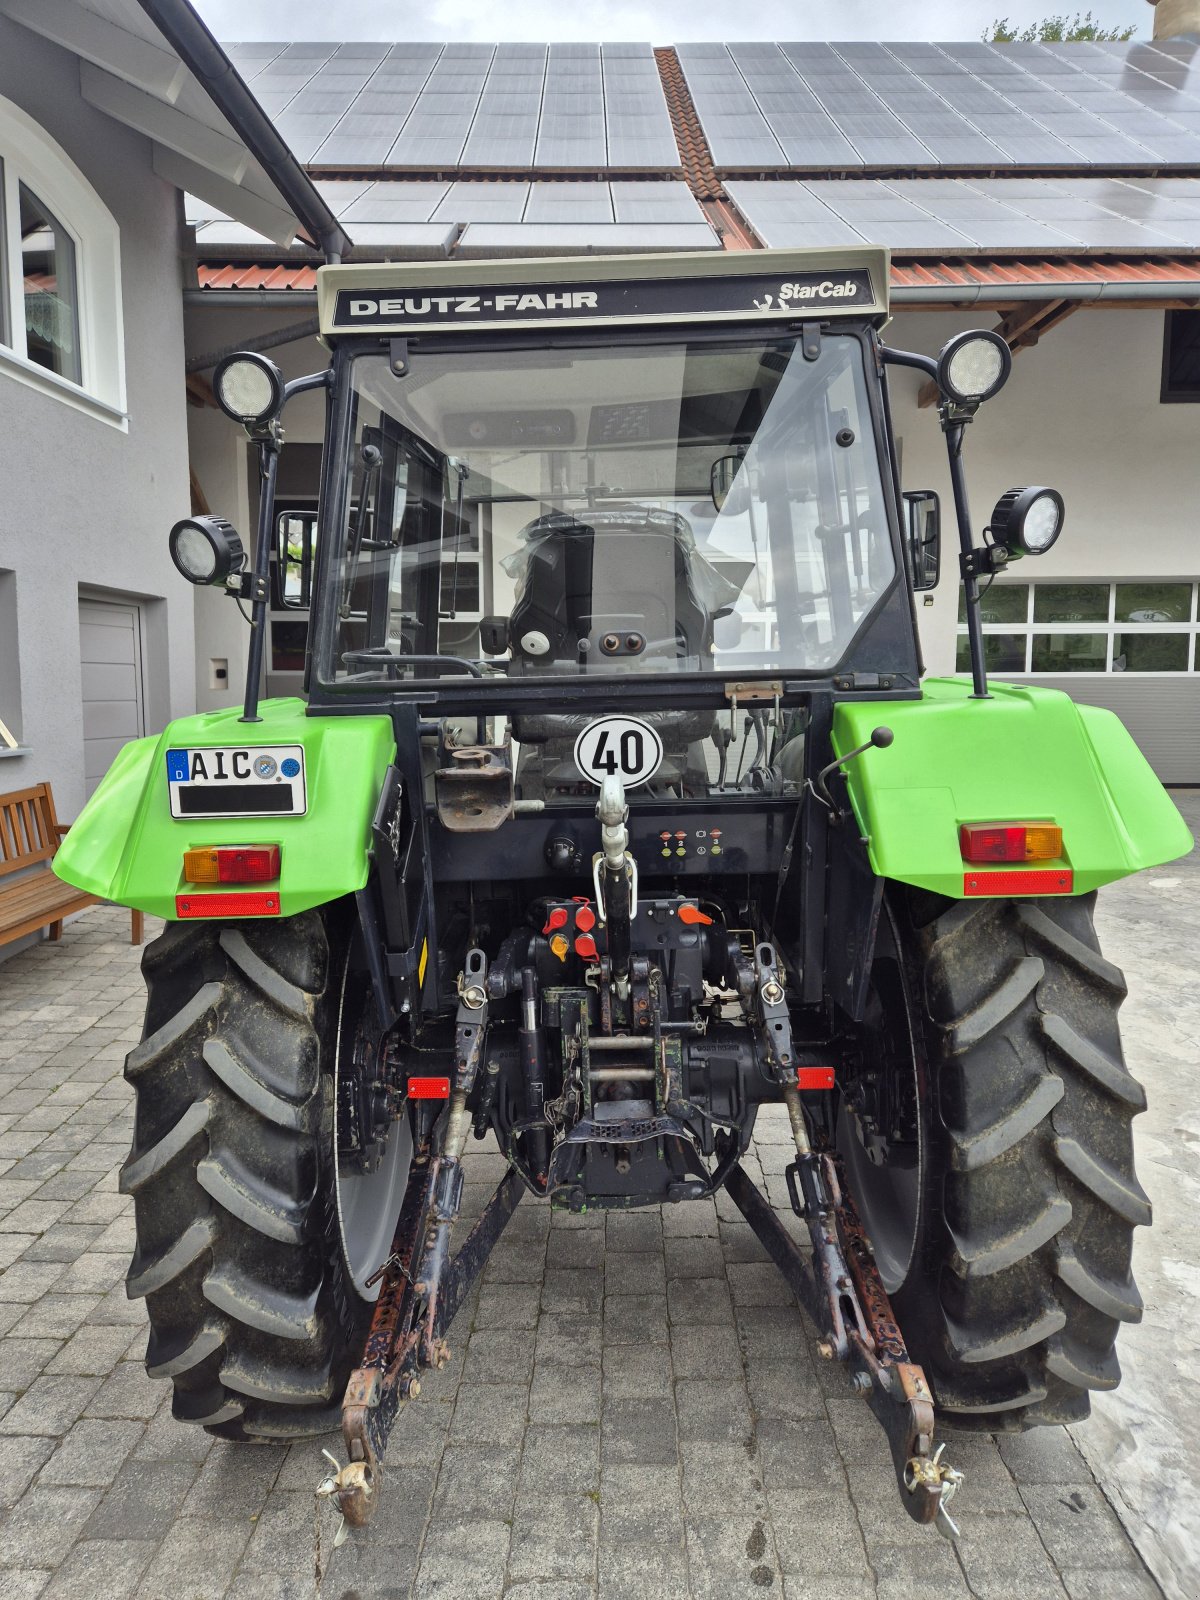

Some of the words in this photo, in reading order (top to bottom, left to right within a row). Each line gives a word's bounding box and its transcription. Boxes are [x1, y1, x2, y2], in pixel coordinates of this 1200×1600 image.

[779, 280, 857, 300] StarCab
[350, 291, 598, 316] DEUTZ-FAHR
[591, 729, 644, 775] 40
[176, 771, 184, 780] D
[190, 751, 251, 780] AIC
